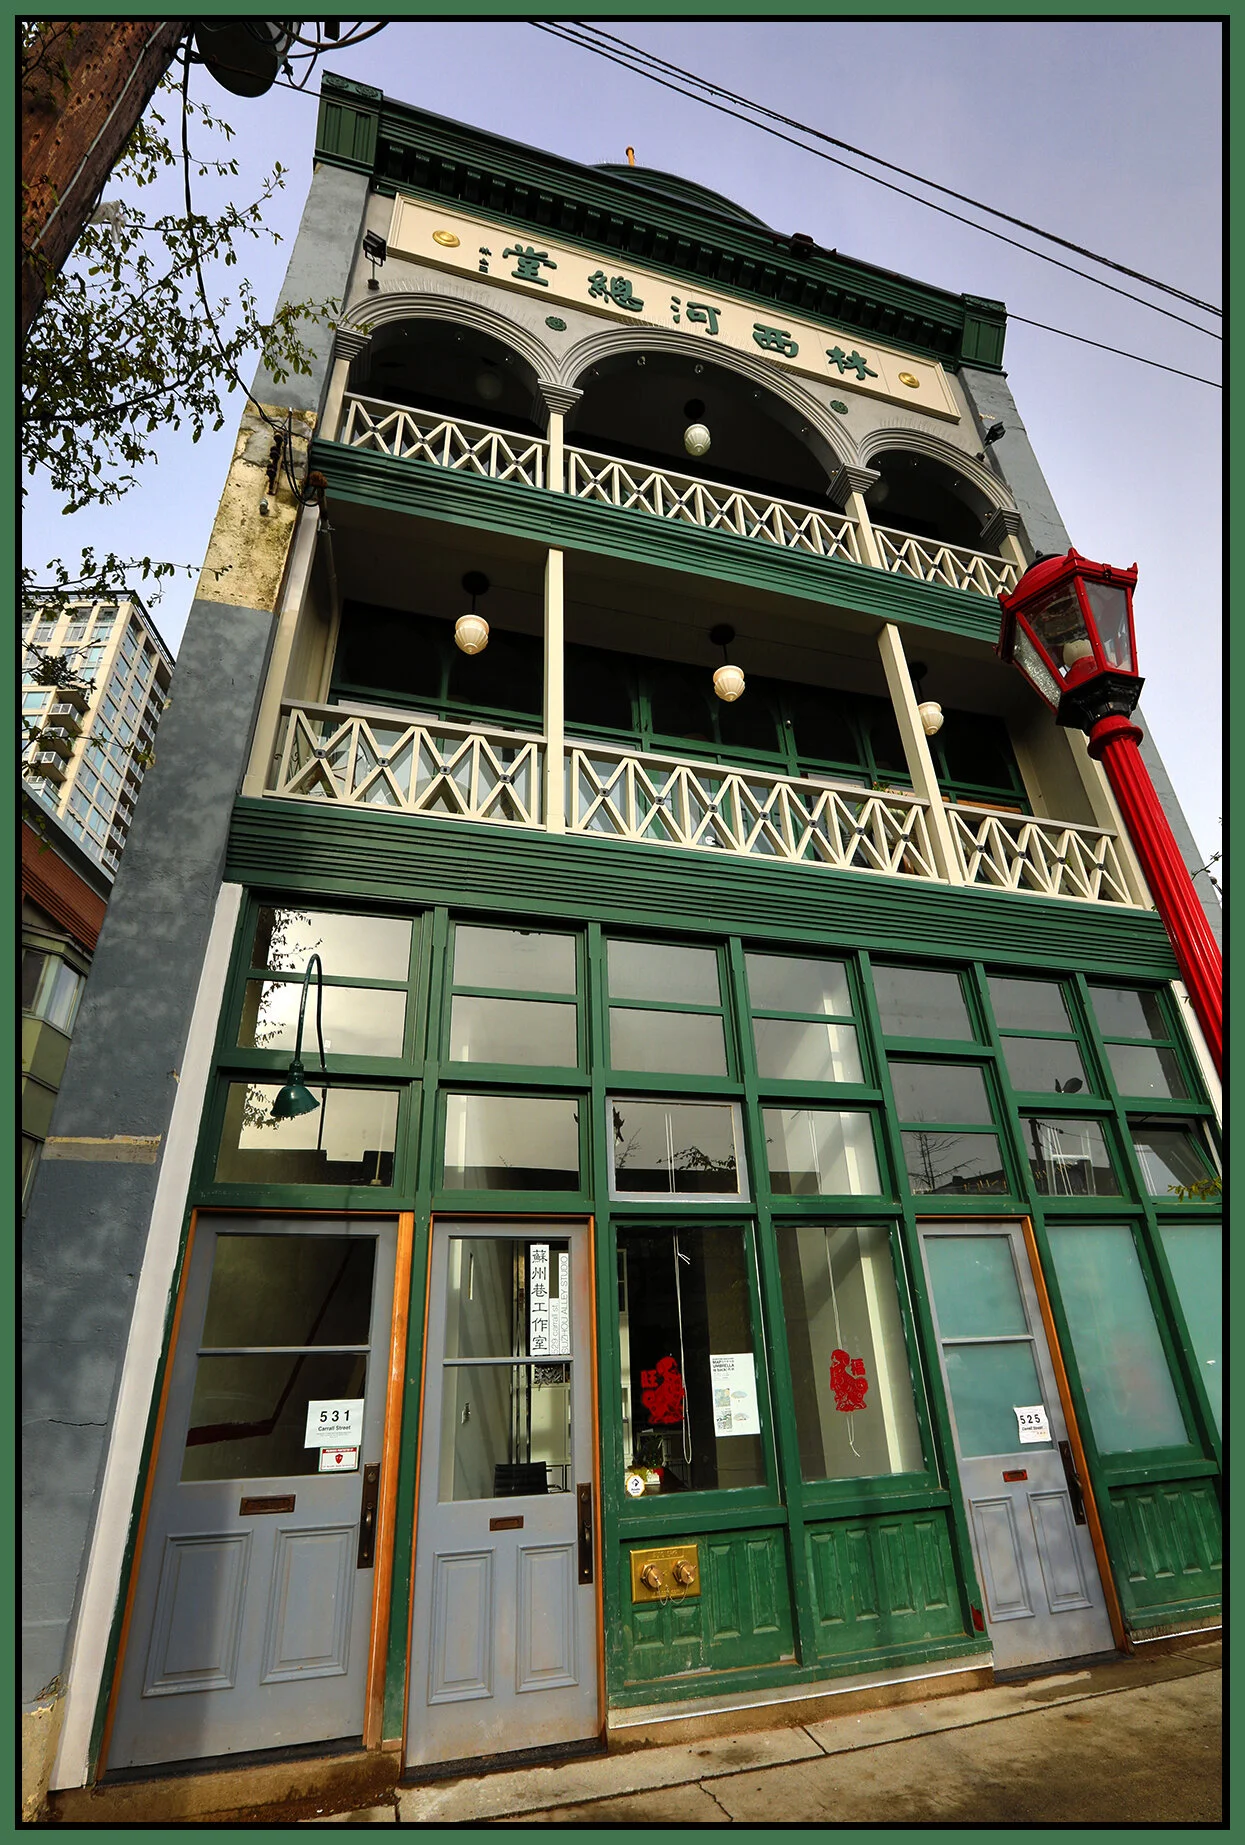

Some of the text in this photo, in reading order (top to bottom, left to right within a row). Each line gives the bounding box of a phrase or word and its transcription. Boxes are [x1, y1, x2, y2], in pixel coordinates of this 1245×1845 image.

[531, 1249, 548, 1350] 蘇州巷工作室
[560, 1255, 568, 1354] SUZHOU ALLEY STUDIO
[319, 1410, 350, 1422] 531
[1020, 1414, 1040, 1424] 525
